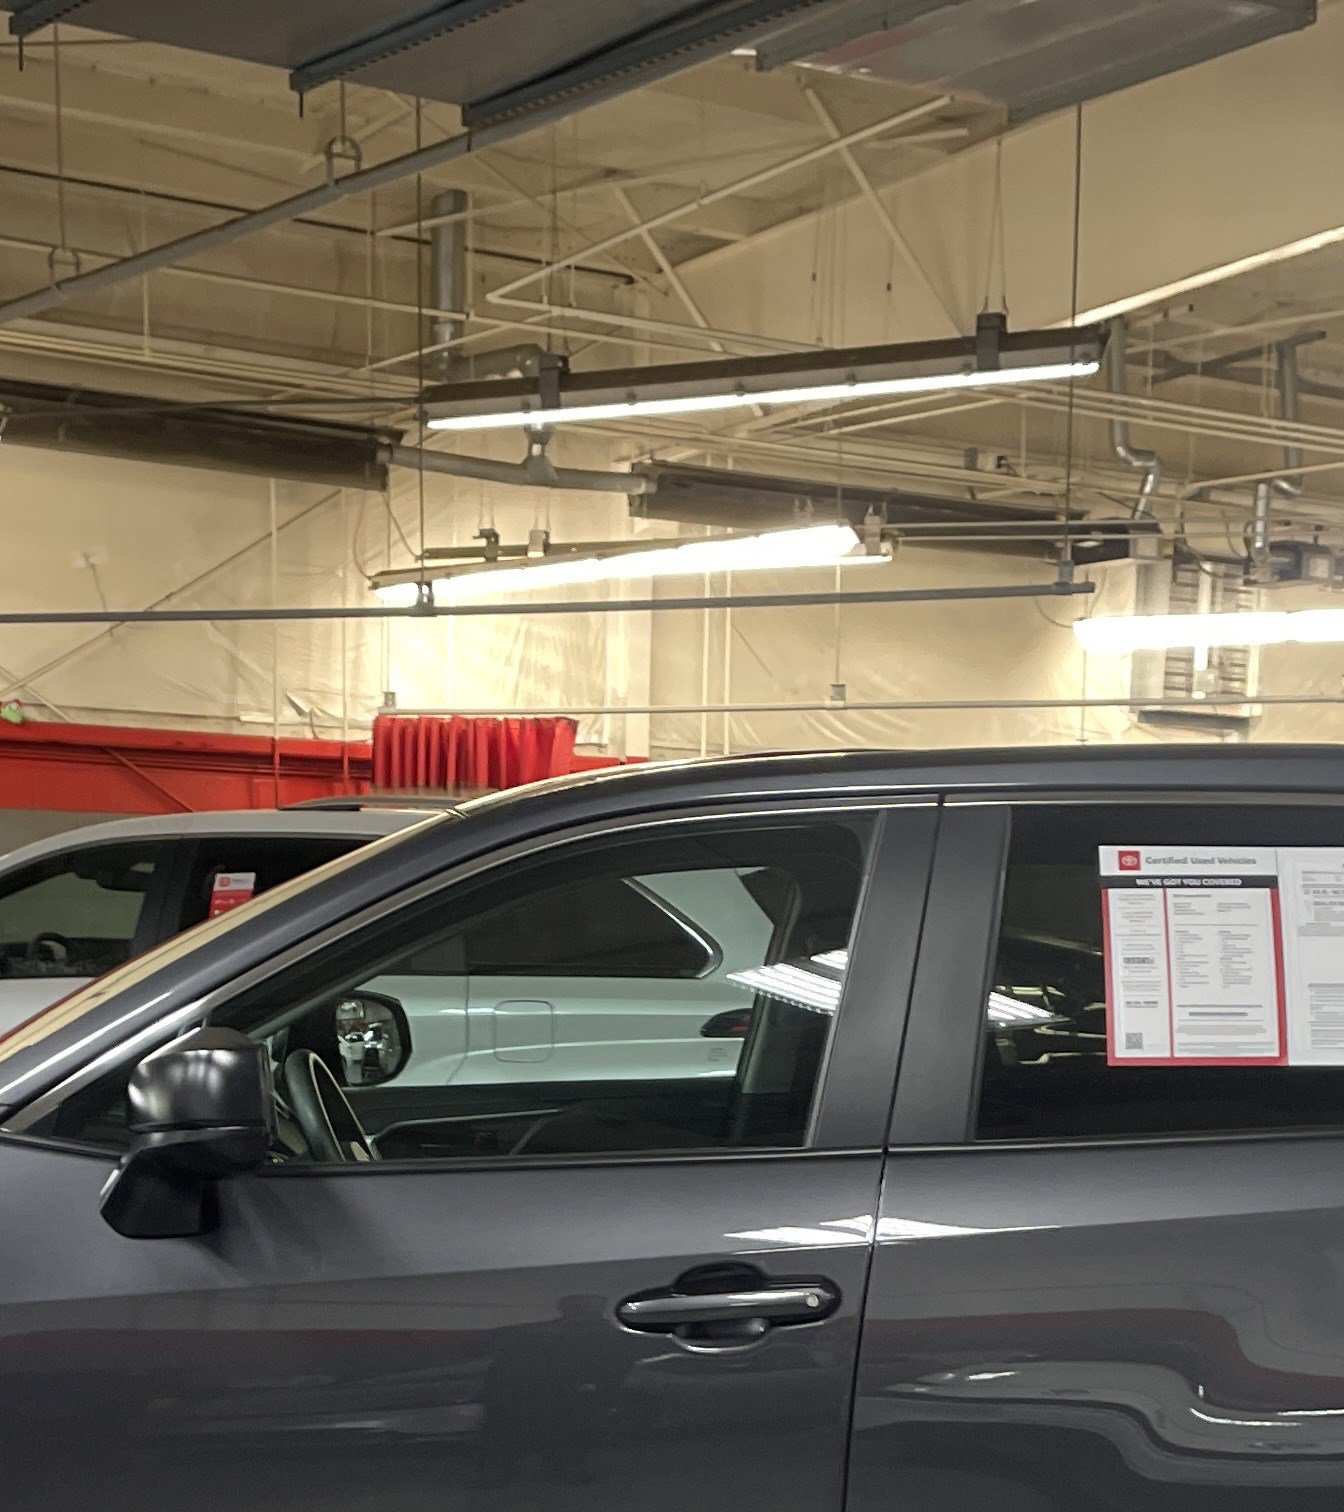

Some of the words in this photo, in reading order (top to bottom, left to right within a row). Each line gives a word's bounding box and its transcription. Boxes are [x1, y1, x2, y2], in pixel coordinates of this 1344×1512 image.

[1145, 856, 1188, 865] Certified
[1190, 856, 1216, 865] Used
[1218, 856, 1257, 865] Vehicles
